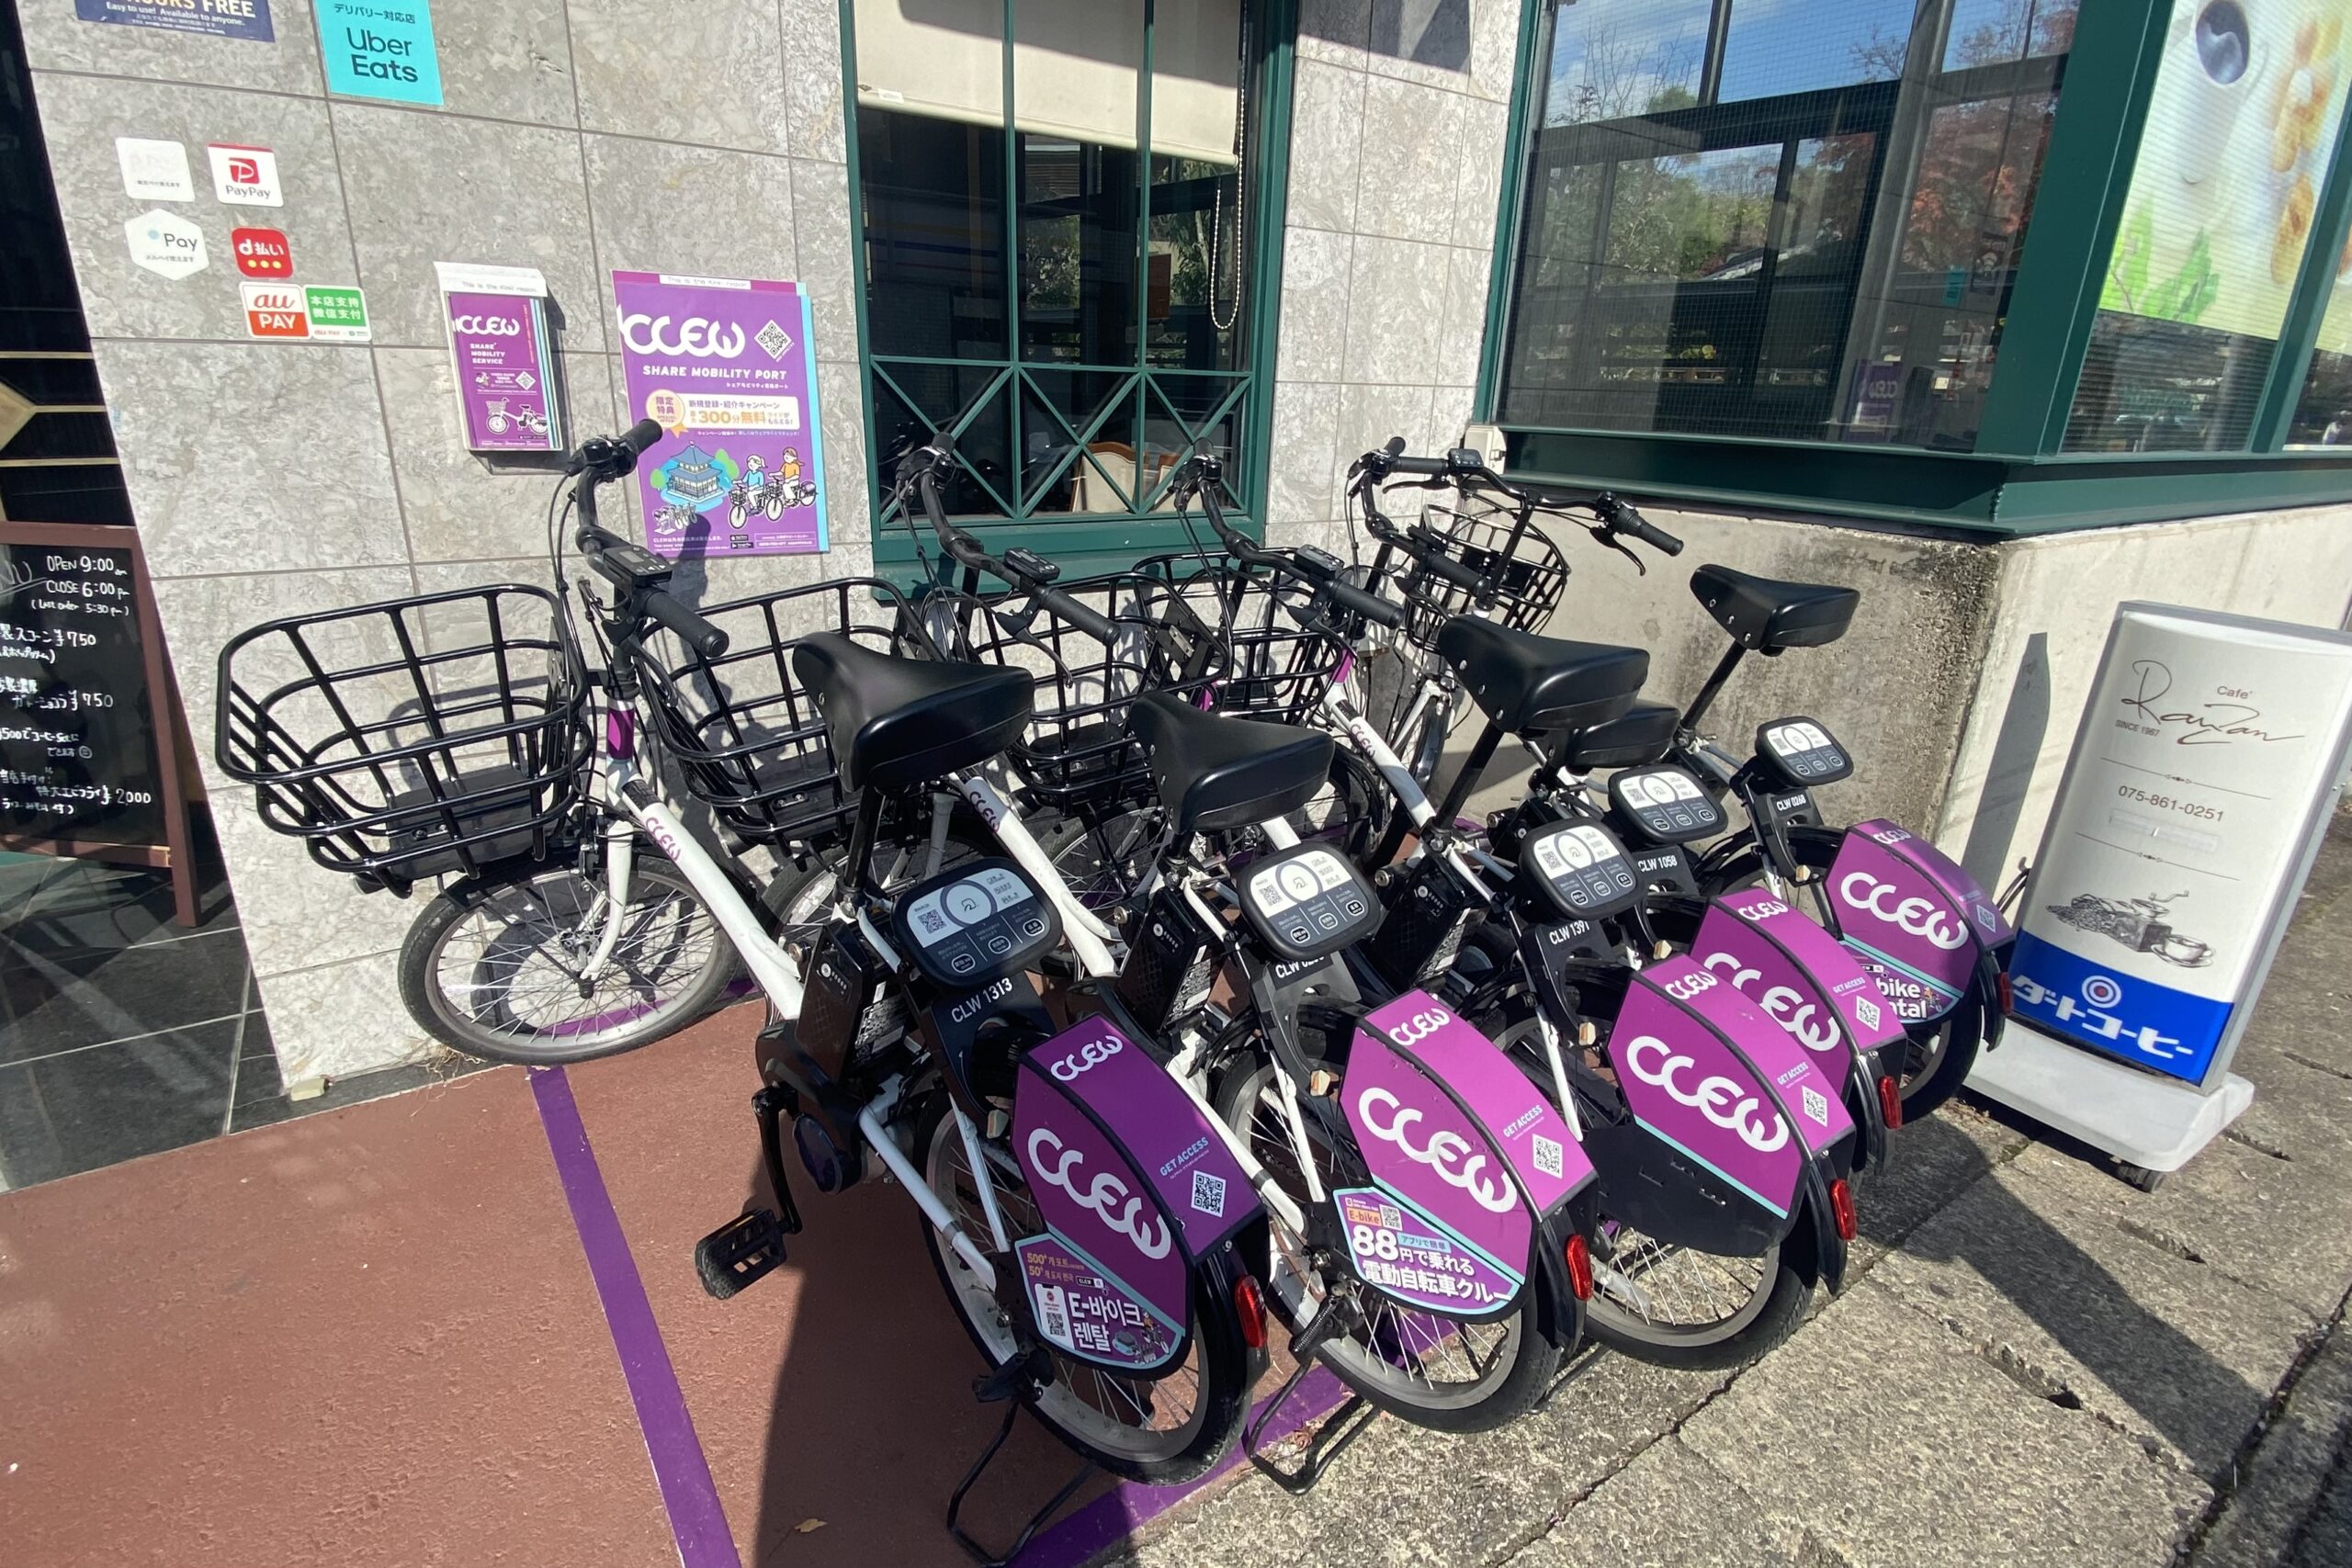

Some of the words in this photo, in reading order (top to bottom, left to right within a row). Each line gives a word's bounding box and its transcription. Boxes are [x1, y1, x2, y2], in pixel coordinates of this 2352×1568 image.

[106, 2, 126, 14] Easy
[138, 6, 157, 14] use!
[160, 8, 198, 19] Available
[211, 16, 245, 26] anyone.
[202, 0, 256, 18] FREE
[334, 4, 416, 24] デリバリー対応店
[346, 27, 413, 56] Uber
[351, 53, 418, 83] Eats
[225, 185, 271, 199] PayPay
[164, 232, 198, 252] Pay
[238, 239, 284, 256] d払い
[254, 294, 295, 309] au
[258, 313, 296, 329] PAY
[643, 365, 686, 377] SHARE
[691, 367, 751, 378] MOBILITY
[755, 369, 787, 380] PORT
[47, 555, 77, 571] OPEN
[80, 556, 114, 572] 9:00
[47, 580, 79, 594] CLOSE
[82, 581, 115, 597] 6:00
[85, 604, 108, 614] 5:30
[2115, 720, 2140, 732] SINCE
[1776, 796, 1792, 811] CLW
[2118, 784, 2225, 823] 075-861-0251
[1638, 859, 1657, 873] CLW
[1657, 854, 1679, 868] 1058
[1549, 923, 1571, 945] CLW
[1275, 961, 1300, 978] CLW
[1833, 983, 1846, 994] GET
[1845, 976, 1866, 990] ACCESS
[951, 994, 983, 1022] CLW
[982, 976, 1013, 1003] 1313
[2012, 973, 2194, 1058] ダートコーヒー
[1777, 1072, 1791, 1086] GET
[1789, 1061, 1809, 1079] ACCESS
[1503, 1122, 1519, 1139] GET
[1518, 1104, 1544, 1128] ACCESS
[1159, 1157, 1178, 1177] GET
[1177, 1136, 1209, 1166] ACCESS
[1349, 1209, 1380, 1224] E-bike
[1363, 1259, 1512, 1303] 電動自転車クルー
[1068, 1292, 1145, 1327] E-바이크
[1073, 1322, 1112, 1352] 렌탈
